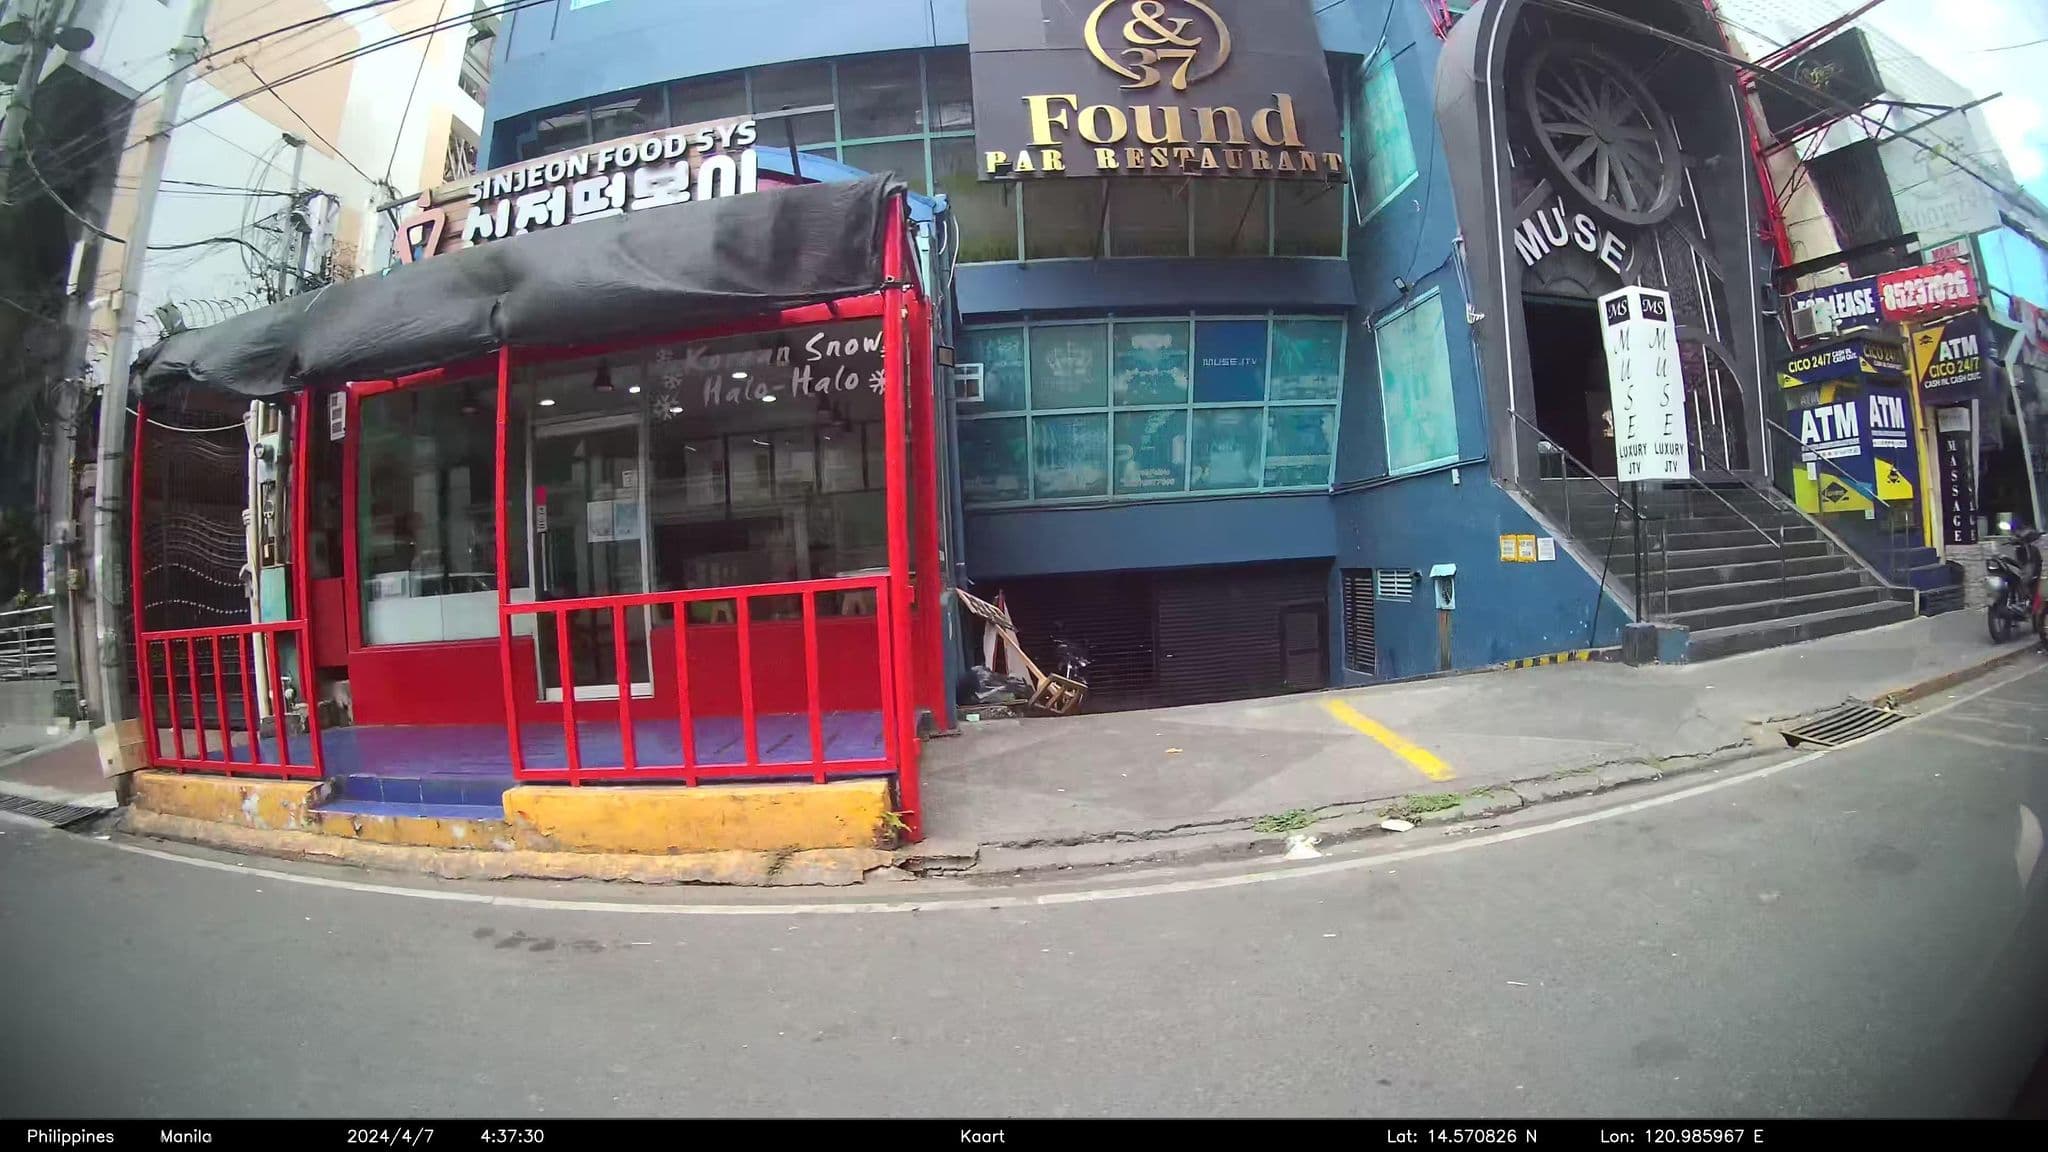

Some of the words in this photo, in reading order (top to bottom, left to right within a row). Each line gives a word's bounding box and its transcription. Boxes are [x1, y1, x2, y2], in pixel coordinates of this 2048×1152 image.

[1120, 48, 1197, 90] 37
[1022, 93, 1305, 147] Found
[469, 152, 590, 204] SINJEON
[597, 135, 686, 172] FOOD
[696, 121, 757, 151] SYS
[984, 149, 1066, 174] PAR
[1095, 147, 1343, 174] RESTAURANT
[1514, 207, 1627, 273] MUSE
[1607, 297, 1629, 321] MS
[1642, 297, 1665, 317] MS
[1829, 288, 1876, 319] LEASE
[805, 332, 883, 361] Snow
[1939, 335, 1979, 361] ATM
[1788, 358, 1811, 373] CICO
[1812, 353, 1831, 367] 24/7
[1929, 362, 1955, 378] CICO
[1957, 357, 1979, 373] 24/7
[704, 365, 859, 407] Halo-Halo
[1614, 327, 1637, 439] MUSE
[1649, 327, 1674, 436] MUSE
[1801, 401, 1860, 444] ATM
[1869, 395, 1905, 428] ATM
[1619, 442, 1648, 458] LUXURY
[1654, 442, 1685, 456] LUXURY
[1628, 459, 1641, 475] JTV
[1664, 459, 1678, 473] JTV
[1946, 440, 1962, 542] MASSAGE
